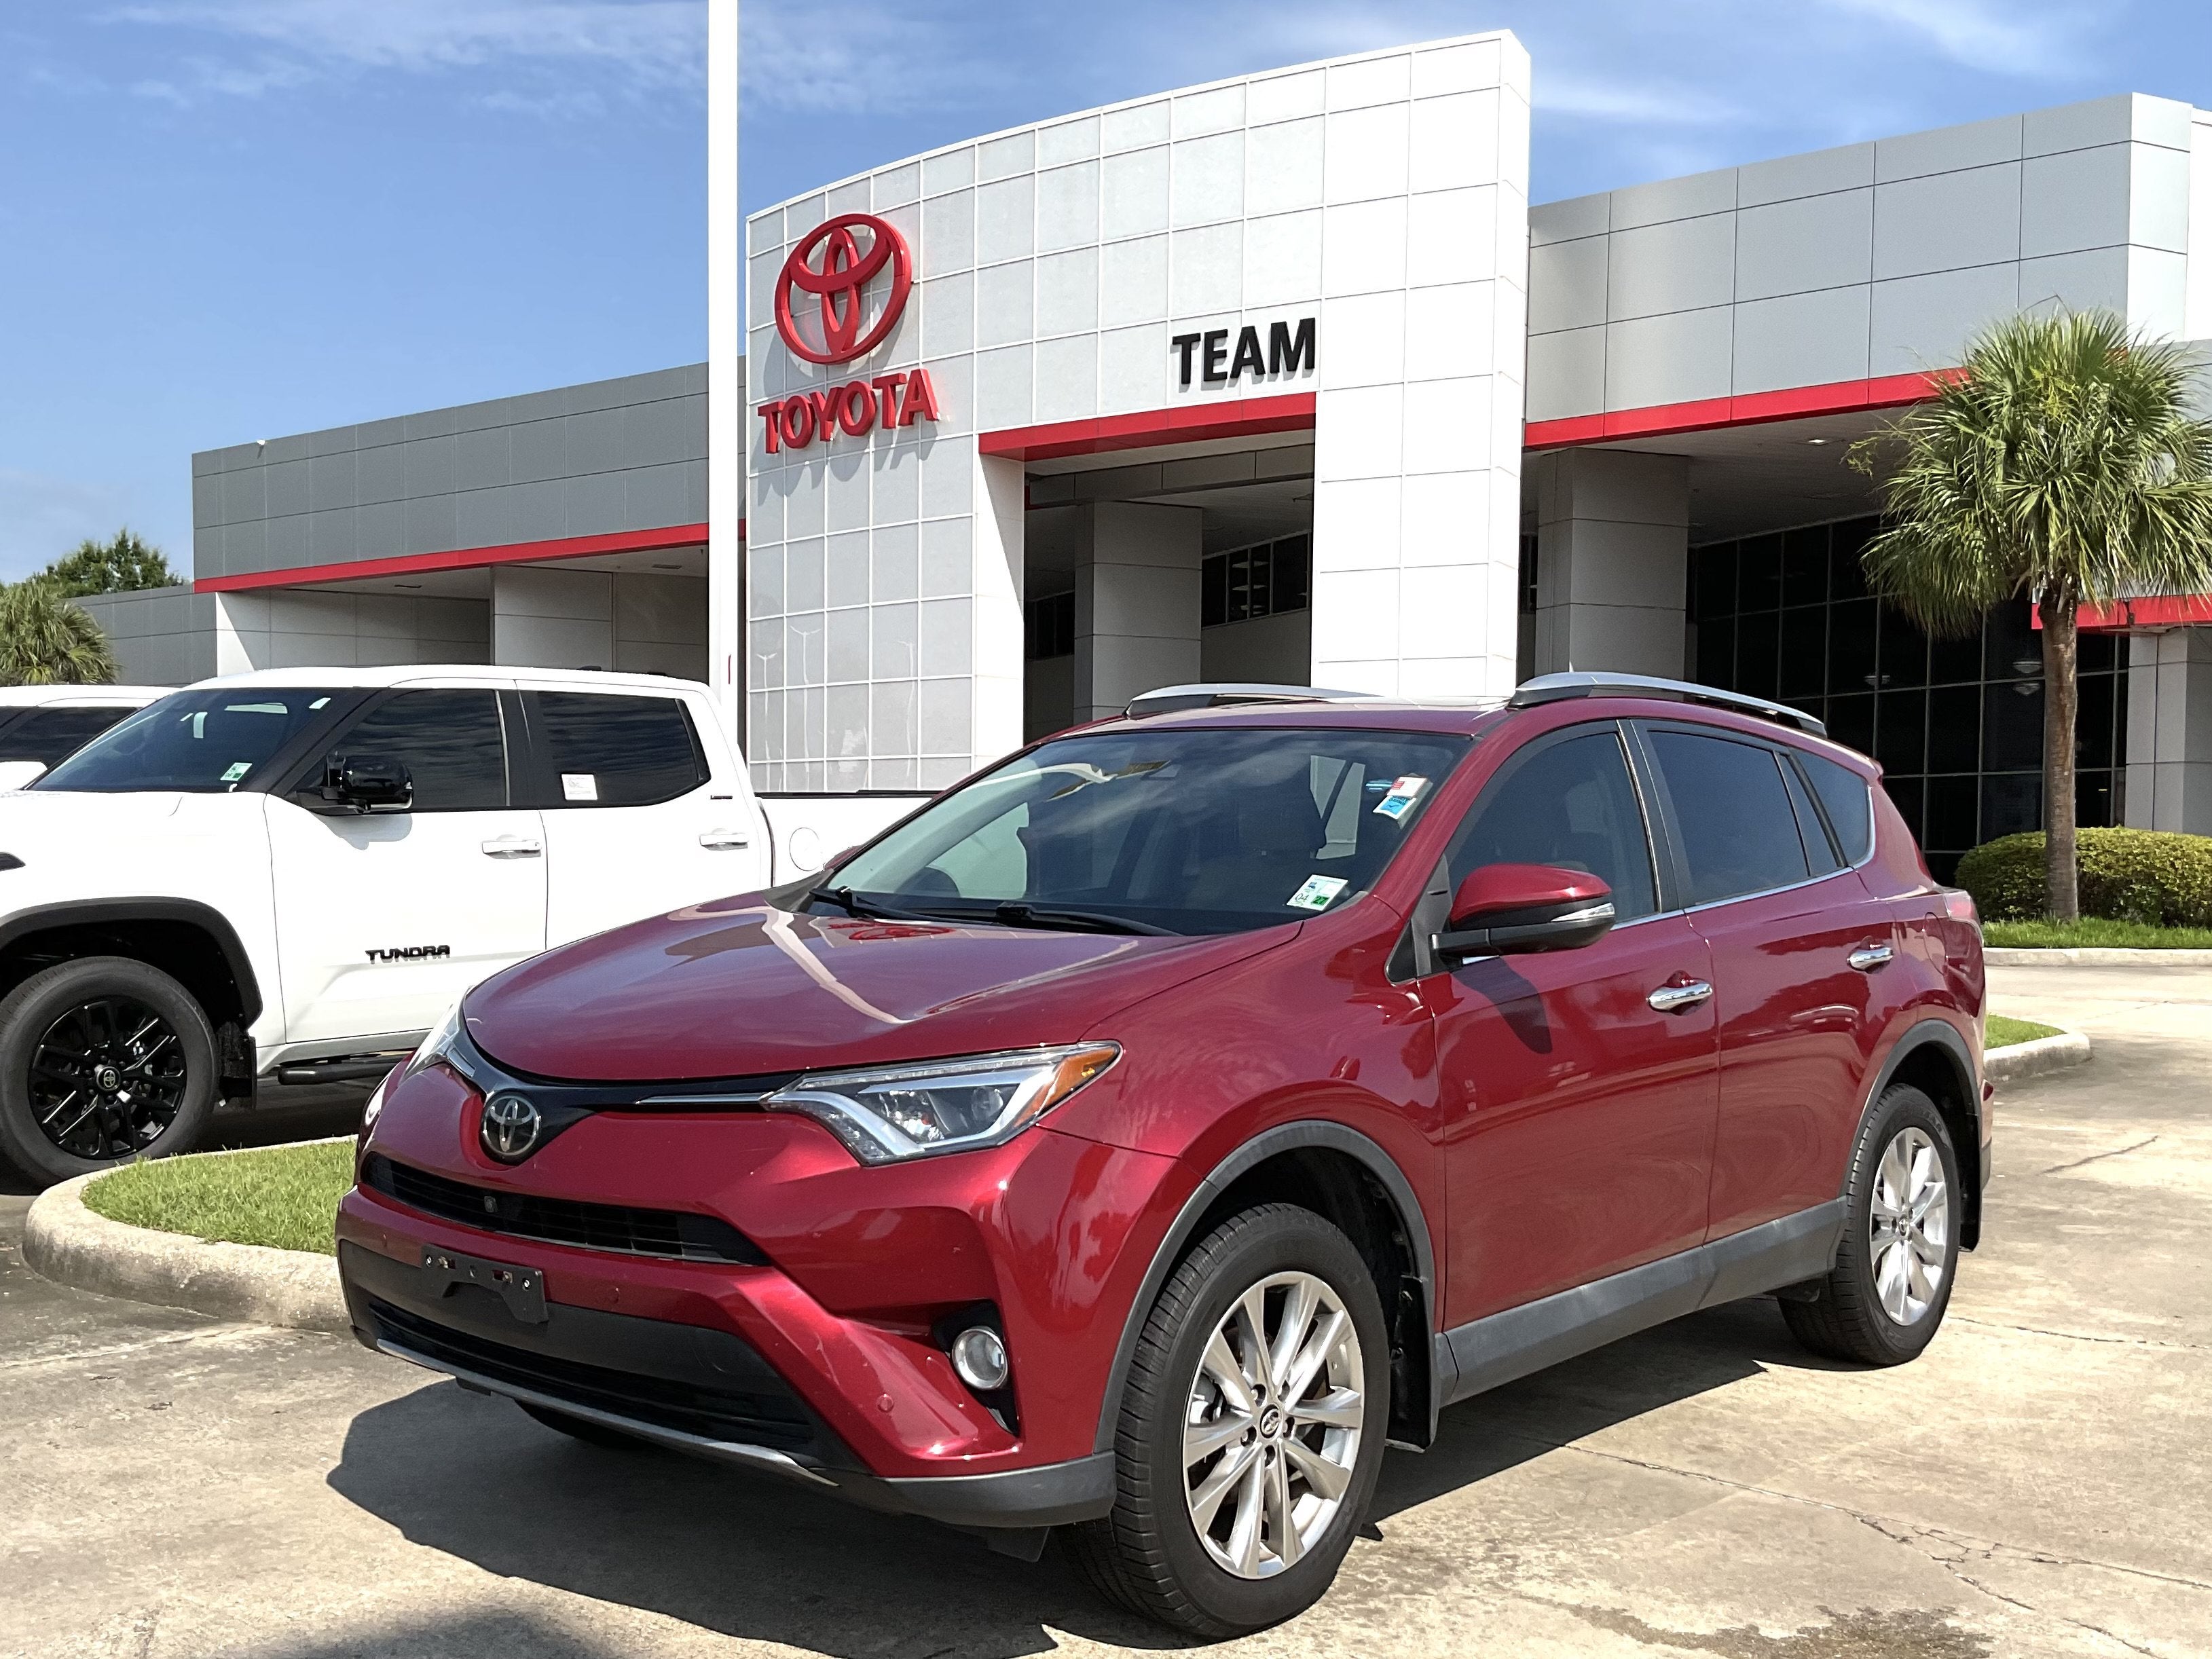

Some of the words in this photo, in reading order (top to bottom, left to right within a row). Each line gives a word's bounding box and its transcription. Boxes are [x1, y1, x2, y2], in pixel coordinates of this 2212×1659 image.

[1173, 318, 1316, 384] TEAM
[758, 369, 940, 453] TOYOTA
[1312, 896, 1329, 905] 27
[365, 945, 450, 961] TUNDRA
